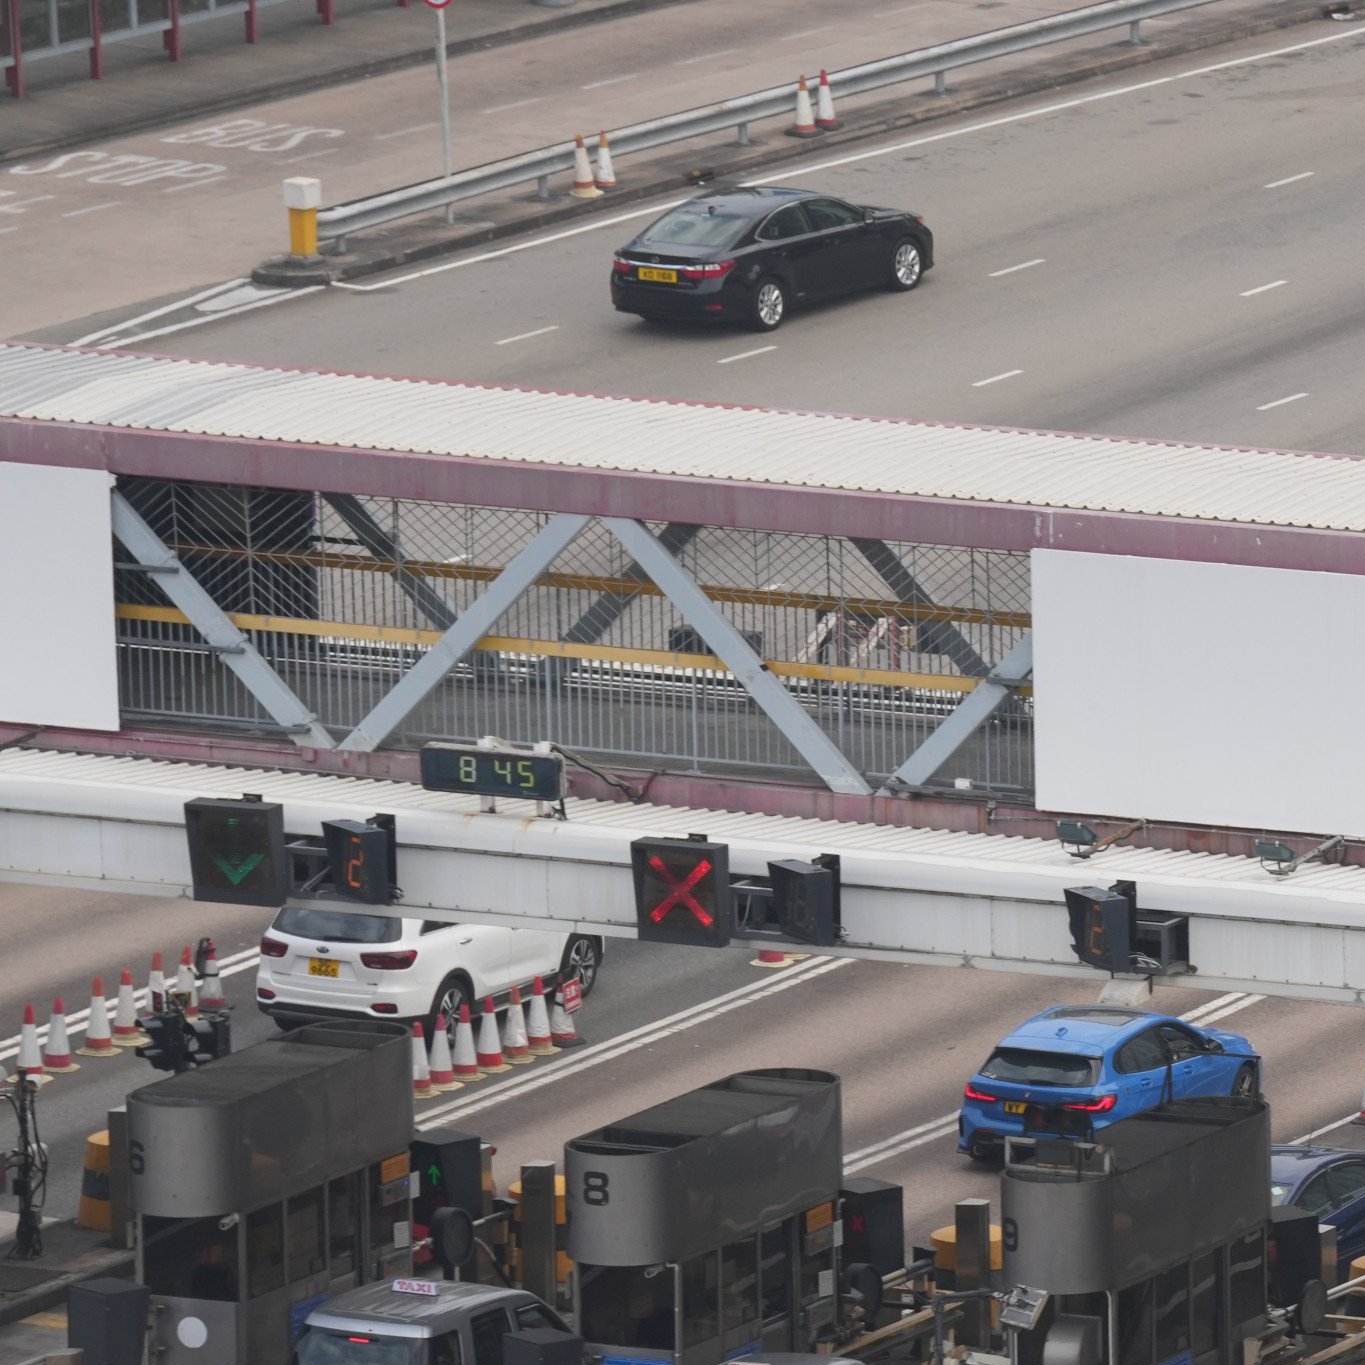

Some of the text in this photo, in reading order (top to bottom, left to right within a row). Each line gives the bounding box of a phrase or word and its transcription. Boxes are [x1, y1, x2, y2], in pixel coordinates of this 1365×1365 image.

[161, 119, 346, 152] BUS
[9, 151, 228, 187] STOP
[459, 756, 537, 787] 8 45
[584, 1171, 609, 1206] 8
[397, 1281, 433, 1293] TAXI
